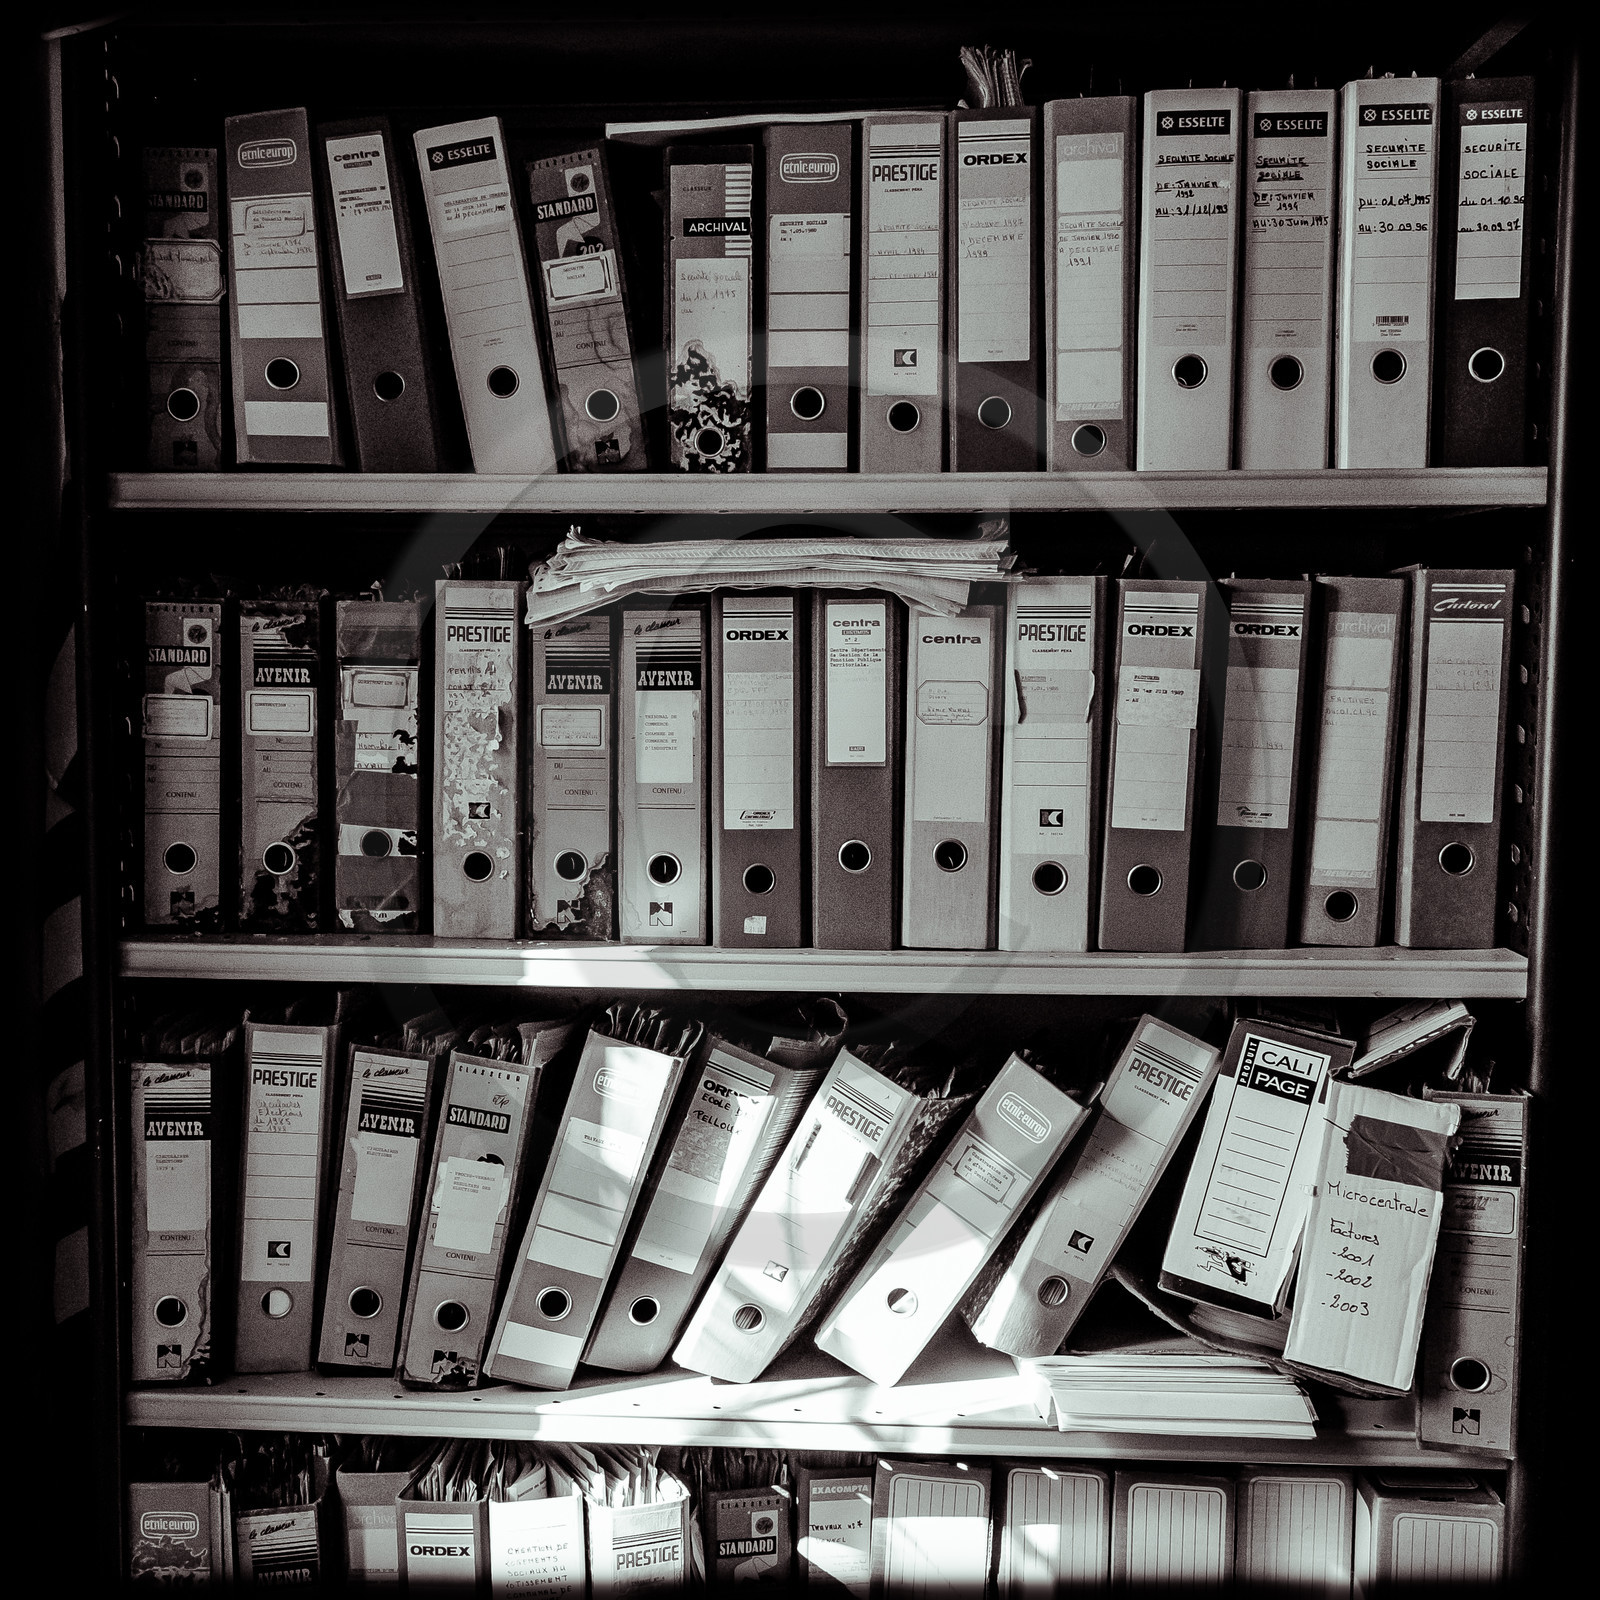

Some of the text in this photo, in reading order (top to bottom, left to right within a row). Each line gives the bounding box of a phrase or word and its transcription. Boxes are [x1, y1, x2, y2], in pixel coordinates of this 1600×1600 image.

[1178, 116, 1225, 128] ESSELTE
[1381, 108, 1430, 121] ESSELTE
[1481, 108, 1523, 120] ESSELTE
[1276, 119, 1323, 131] ESSELTE
[333, 150, 380, 162] centra
[448, 143, 491, 161] ESSELTE
[1063, 138, 1119, 156] archival
[963, 152, 1028, 166] ORDEX
[872, 163, 938, 182] PRESTIGE
[1463, 164, 1519, 180] SOCIALE
[537, 196, 594, 220] STANDARD
[689, 222, 748, 233] ARCHIVAL
[832, 618, 881, 628] centra
[1127, 624, 1194, 637] ORDEX
[1234, 624, 1300, 637] ORDEX
[1334, 616, 1390, 634] archival
[447, 625, 511, 643] PRESTIGE
[726, 630, 789, 641] ORDEX
[922, 633, 982, 644] centra
[1018, 624, 1086, 643] PRESTIGE
[148, 648, 207, 664] STANDARD
[255, 667, 311, 683] AVENIR
[547, 675, 603, 690] AVENIR
[637, 670, 694, 686] AVENIR
[1240, 1041, 1258, 1083] PRODUIT
[1261, 1051, 1314, 1076] CALI
[252, 1069, 318, 1088] PRESTIGE
[458, 1065, 522, 1083] CLASSEUR
[1129, 1057, 1195, 1102] PRESTIGE
[1254, 1071, 1310, 1100] PAGE
[702, 1092, 732, 1111] ECOLE
[360, 1112, 415, 1134] AVENIR
[449, 1107, 508, 1130] STANDARD
[824, 1095, 884, 1143] PRESTIGE
[146, 1121, 204, 1136] AVENIR
[1327, 1180, 1430, 1218] Microcentrale
[1330, 1217, 1380, 1246] Factures
[445, 1251, 476, 1262] CONTENU
[812, 1484, 869, 1495] EXACOMPTA
[409, 1545, 471, 1557] ORDEX
[719, 1538, 774, 1556] STANDARD
[616, 1544, 680, 1571] PRESTIGE
[257, 1568, 312, 1587] AVENIR
